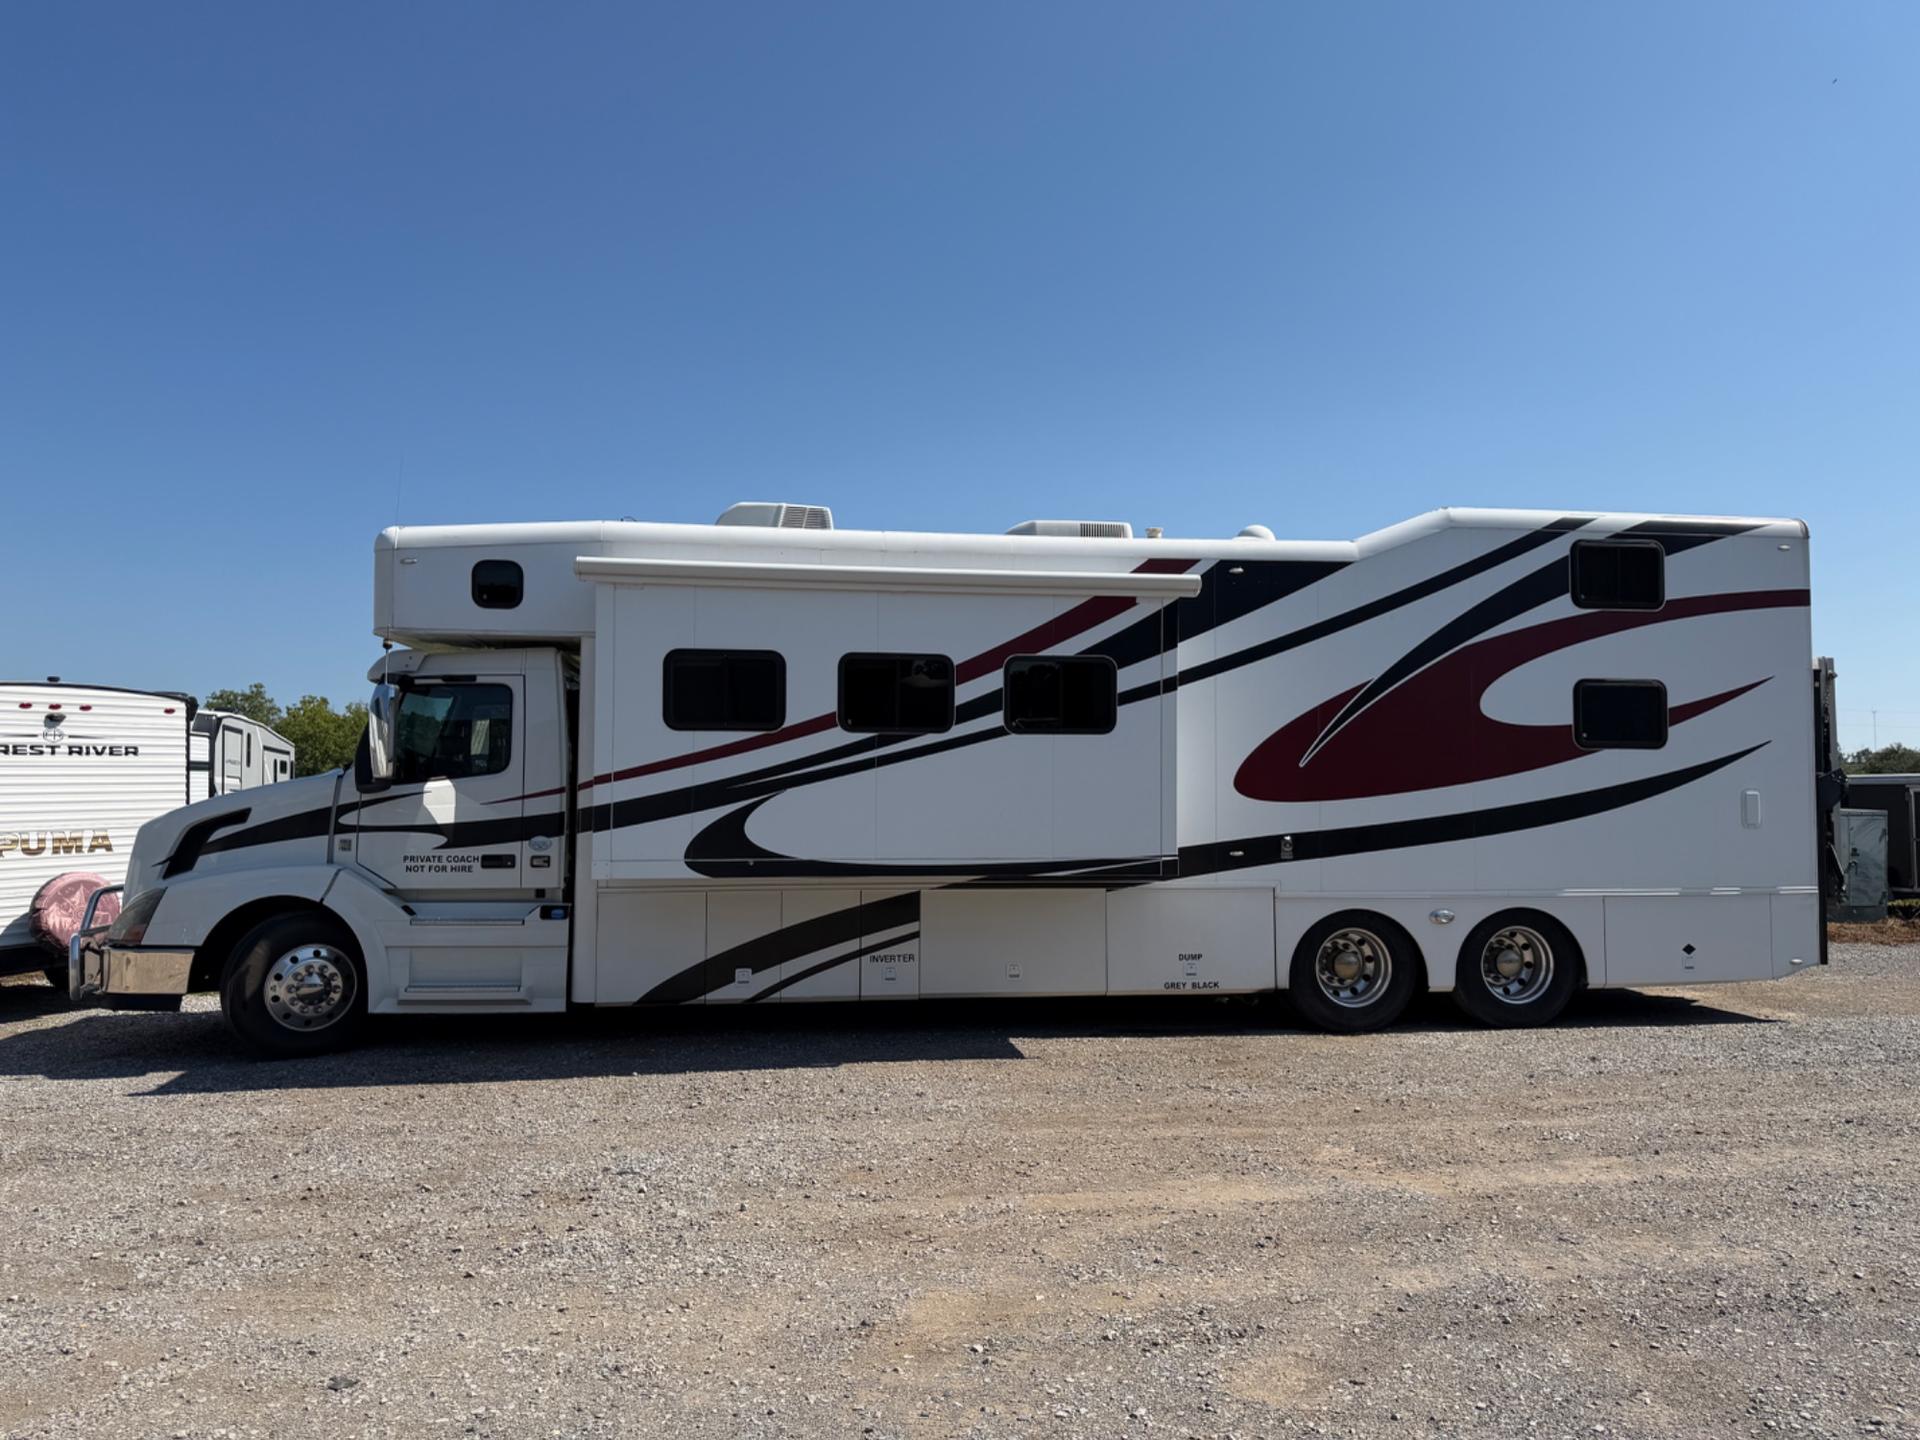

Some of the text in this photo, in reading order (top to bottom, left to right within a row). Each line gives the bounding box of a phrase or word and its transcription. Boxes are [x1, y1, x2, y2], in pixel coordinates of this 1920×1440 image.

[68, 745, 139, 756] RIVER
[403, 855, 479, 863] PRIVATE COACH
[405, 865, 473, 873] NOT FOR HIRE
[869, 954, 915, 963] INVERTER
[1178, 953, 1203, 961] DUMP
[1191, 981, 1220, 989] BLACK
